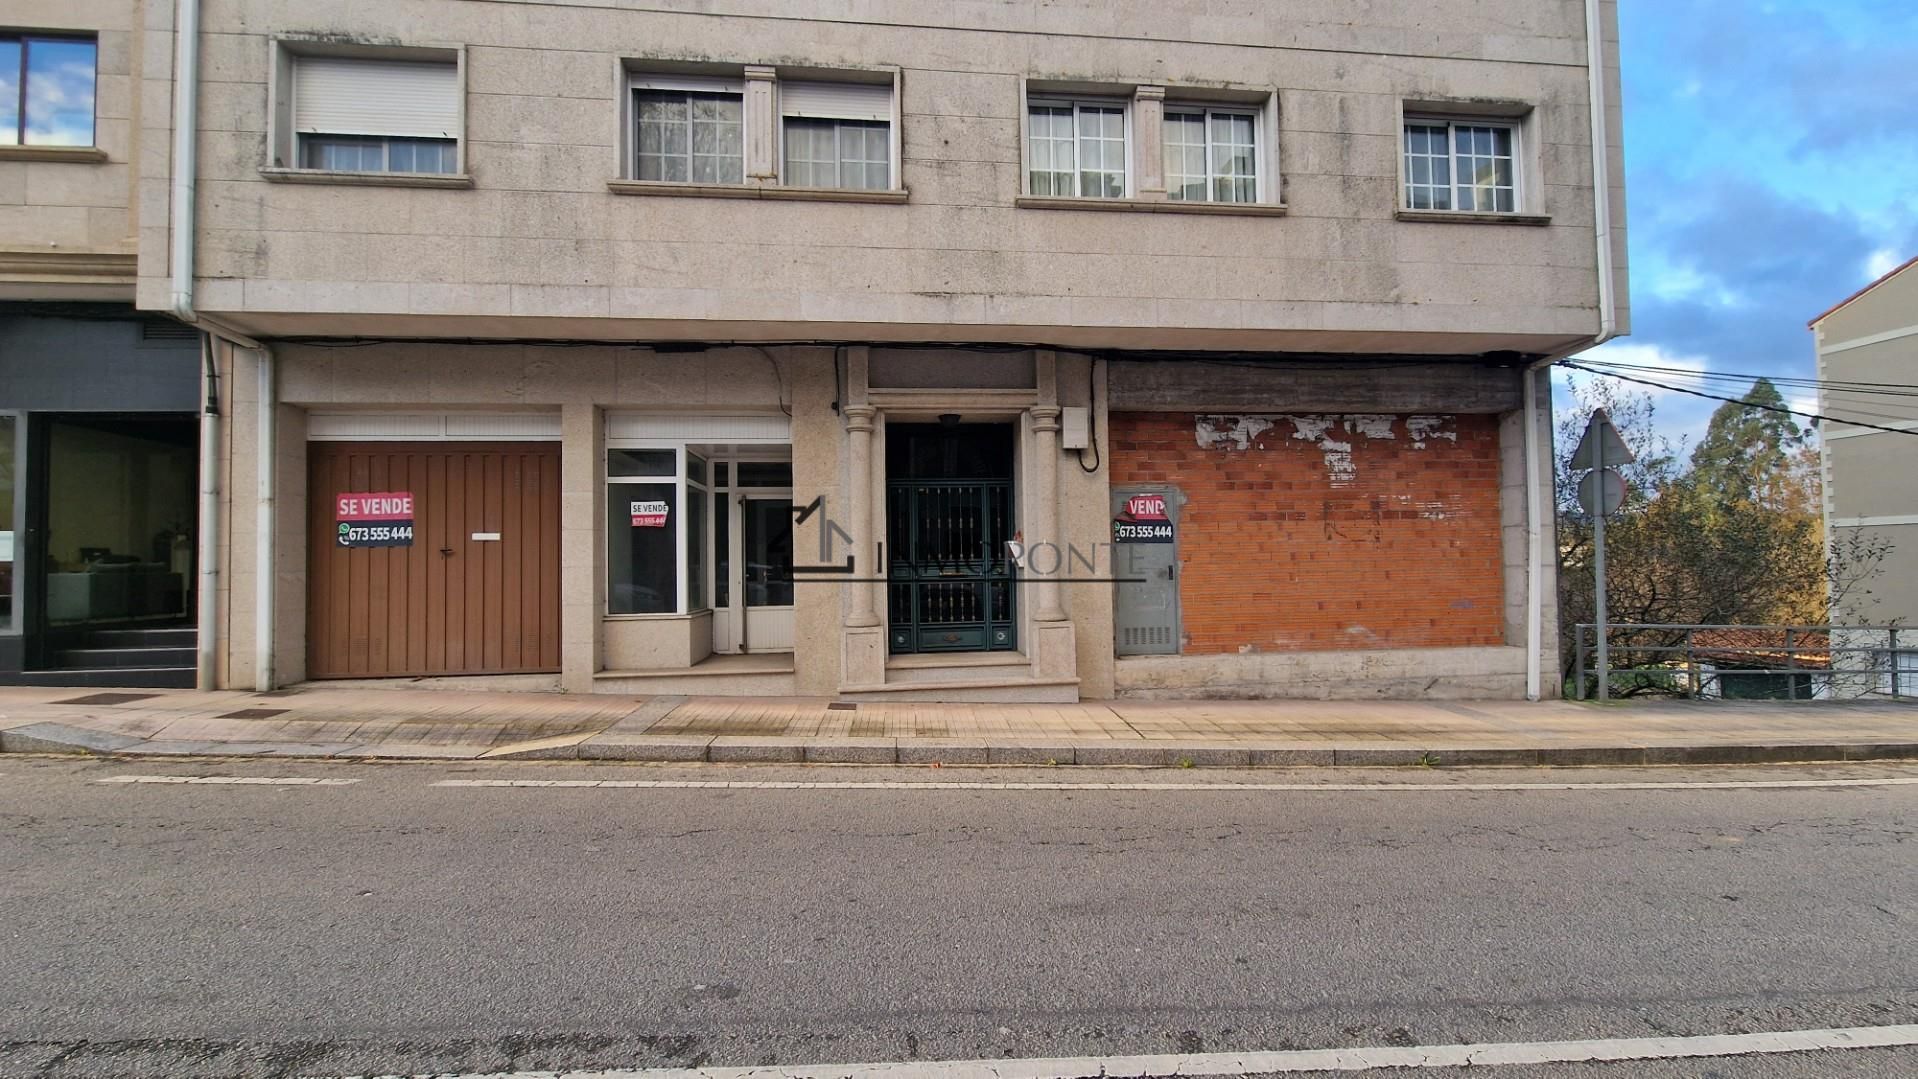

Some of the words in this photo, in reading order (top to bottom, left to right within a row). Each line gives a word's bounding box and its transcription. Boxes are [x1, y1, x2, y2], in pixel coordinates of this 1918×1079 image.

[339, 499, 358, 515] SE
[361, 498, 412, 514] VENDE
[633, 504, 642, 512] SE
[643, 504, 667, 512] VENDE
[349, 527, 369, 540] 673
[369, 527, 390, 540] 555
[391, 526, 413, 539] 444
[1120, 526, 1136, 537] 673
[1137, 526, 1153, 537] 555
[1154, 526, 1172, 537] 444
